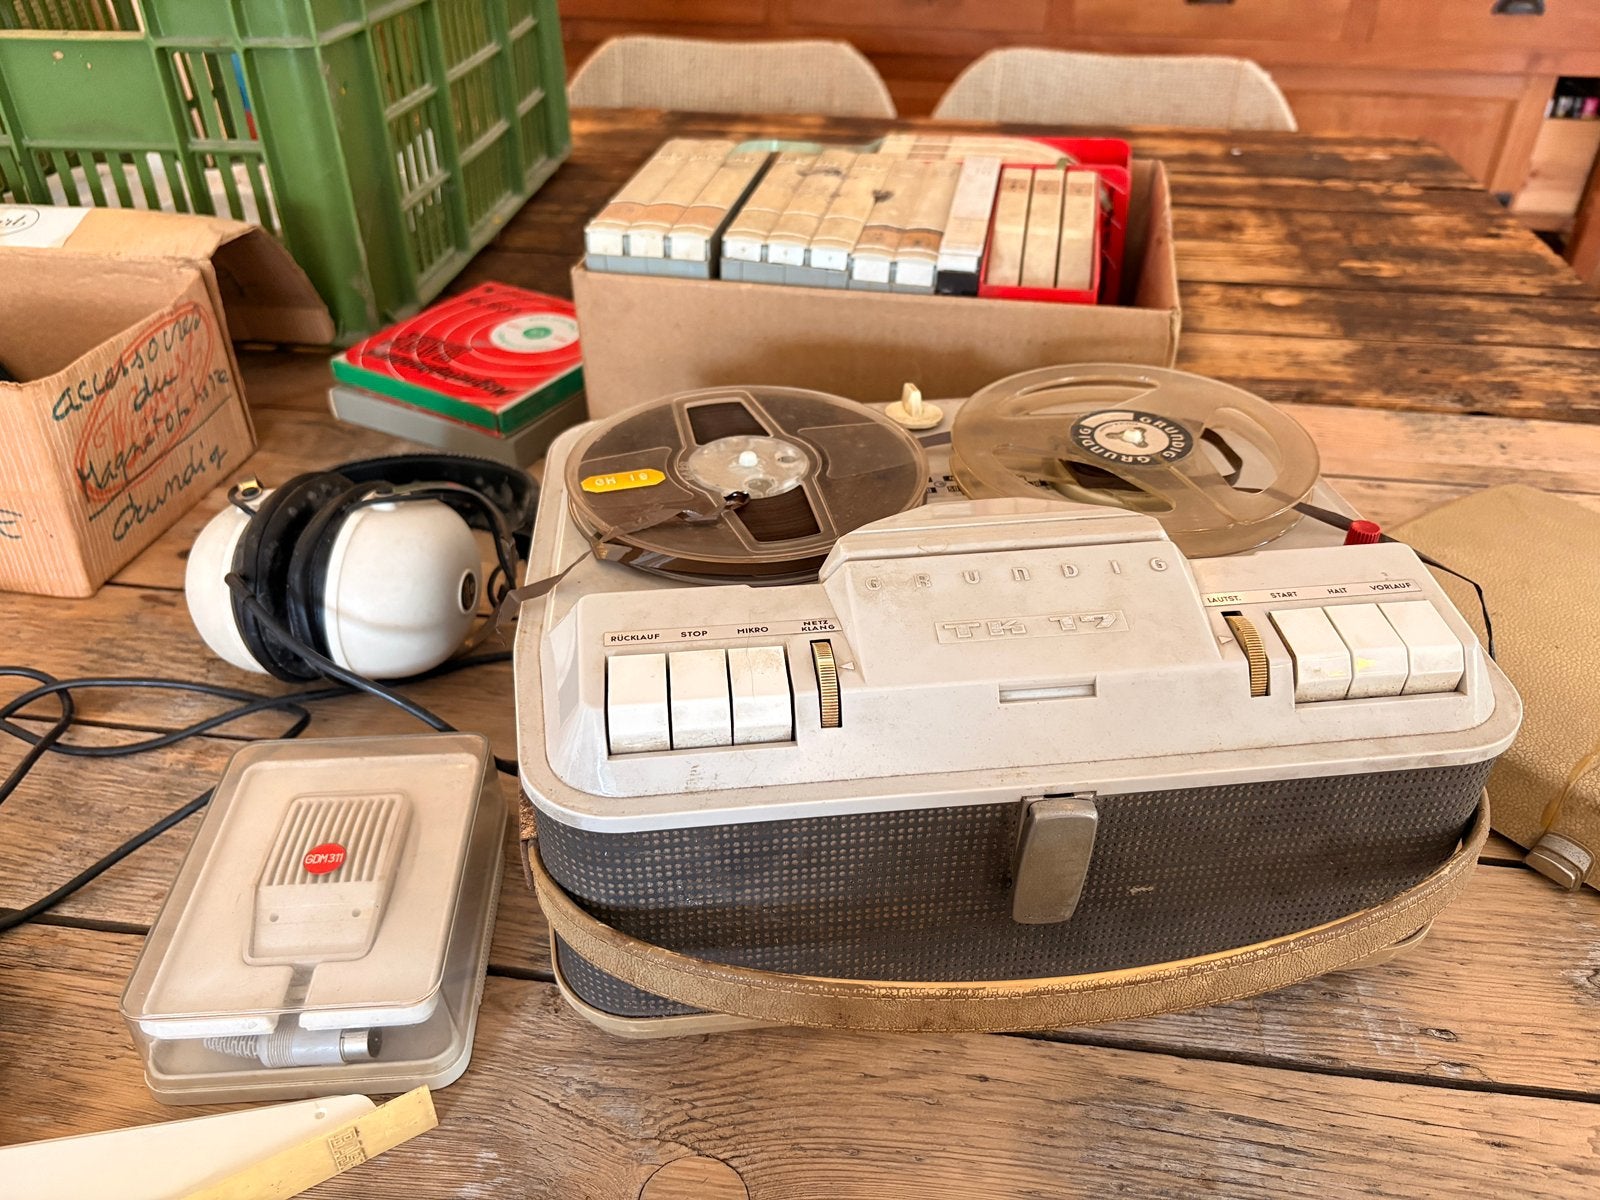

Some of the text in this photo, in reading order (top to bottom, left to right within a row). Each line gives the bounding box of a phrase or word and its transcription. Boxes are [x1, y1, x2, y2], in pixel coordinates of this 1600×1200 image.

[133, 373, 179, 413] du
[1078, 427, 1152, 464] GRUNDIG
[1139, 415, 1187, 459] GRUNDIG
[865, 557, 1168, 591] GRUNDIG
[1327, 587, 1348, 595] HALT
[1369, 582, 1411, 590] VORLAUF
[610, 626, 769, 643] RÜCKLAUF STOP MIKRO
[943, 611, 1118, 638] TK 17
